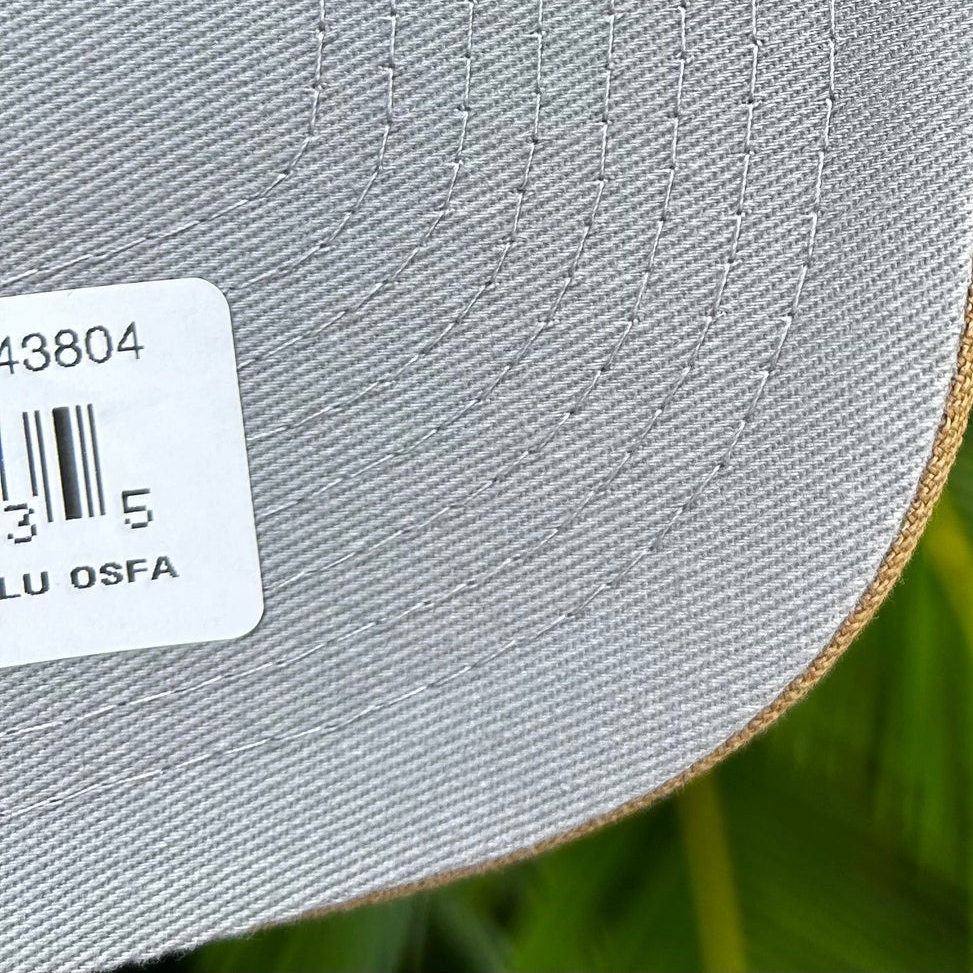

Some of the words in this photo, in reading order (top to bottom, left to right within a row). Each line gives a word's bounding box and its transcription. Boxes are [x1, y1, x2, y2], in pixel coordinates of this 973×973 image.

[0, 321, 145, 374] 43804
[121, 488, 153, 529] 5
[70, 555, 180, 589] OSFA
